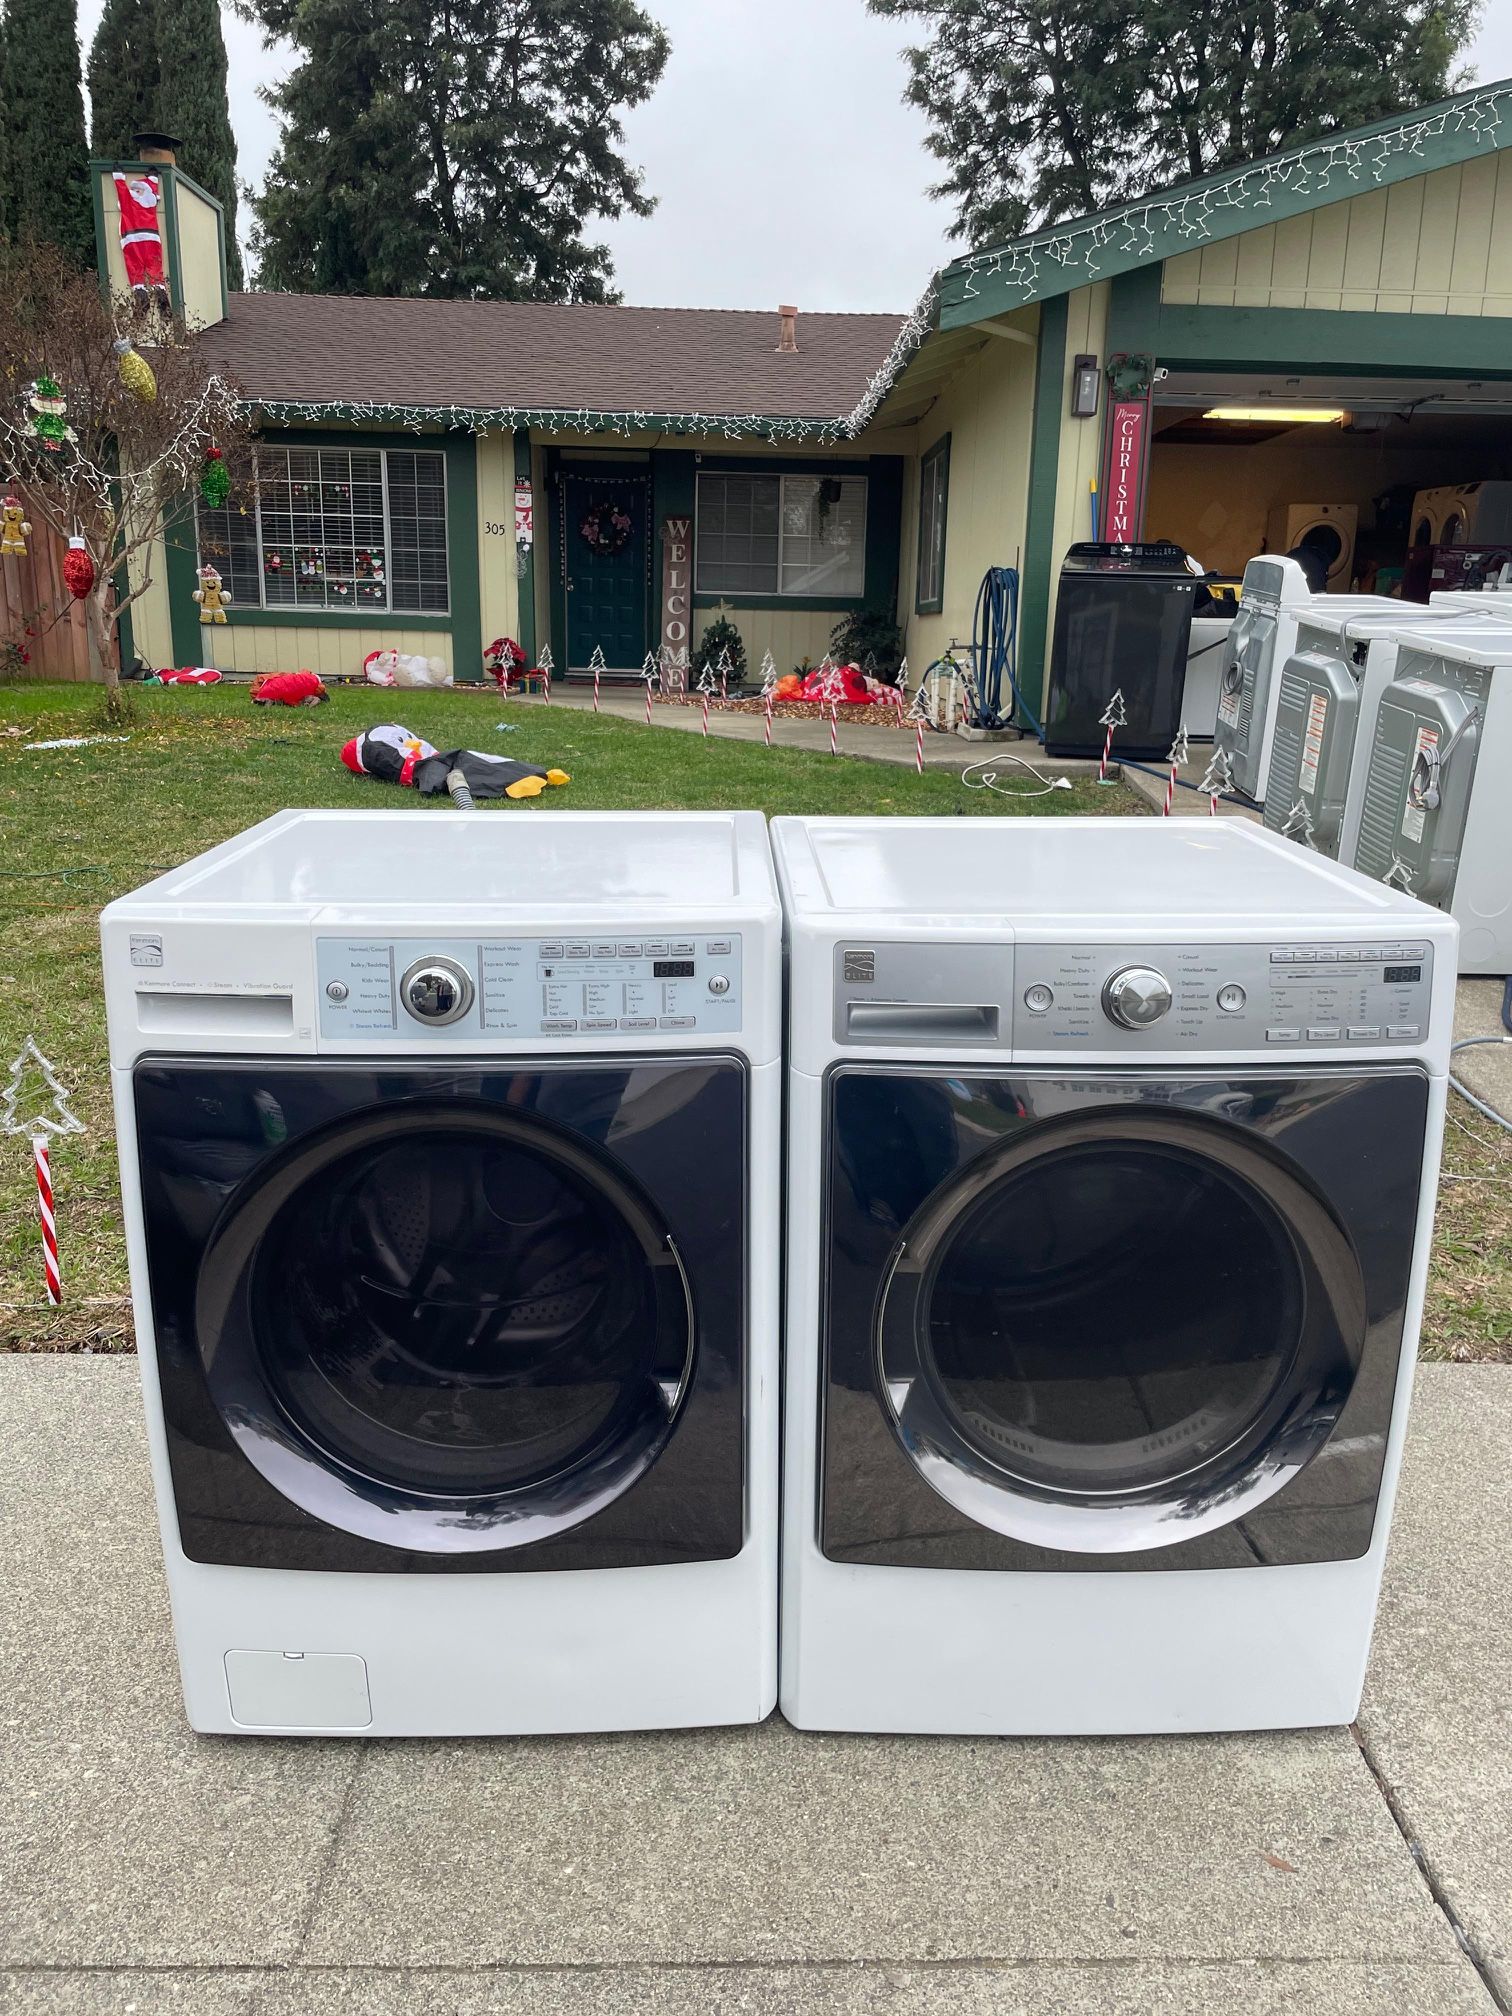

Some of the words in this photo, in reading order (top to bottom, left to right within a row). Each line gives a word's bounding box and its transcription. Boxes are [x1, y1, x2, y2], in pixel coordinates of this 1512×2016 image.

[1116, 408, 1141, 423] Merry
[1112, 420, 1134, 543] CHRISTMA
[485, 521, 505, 536] 305
[665, 520, 690, 687] WELCOME
